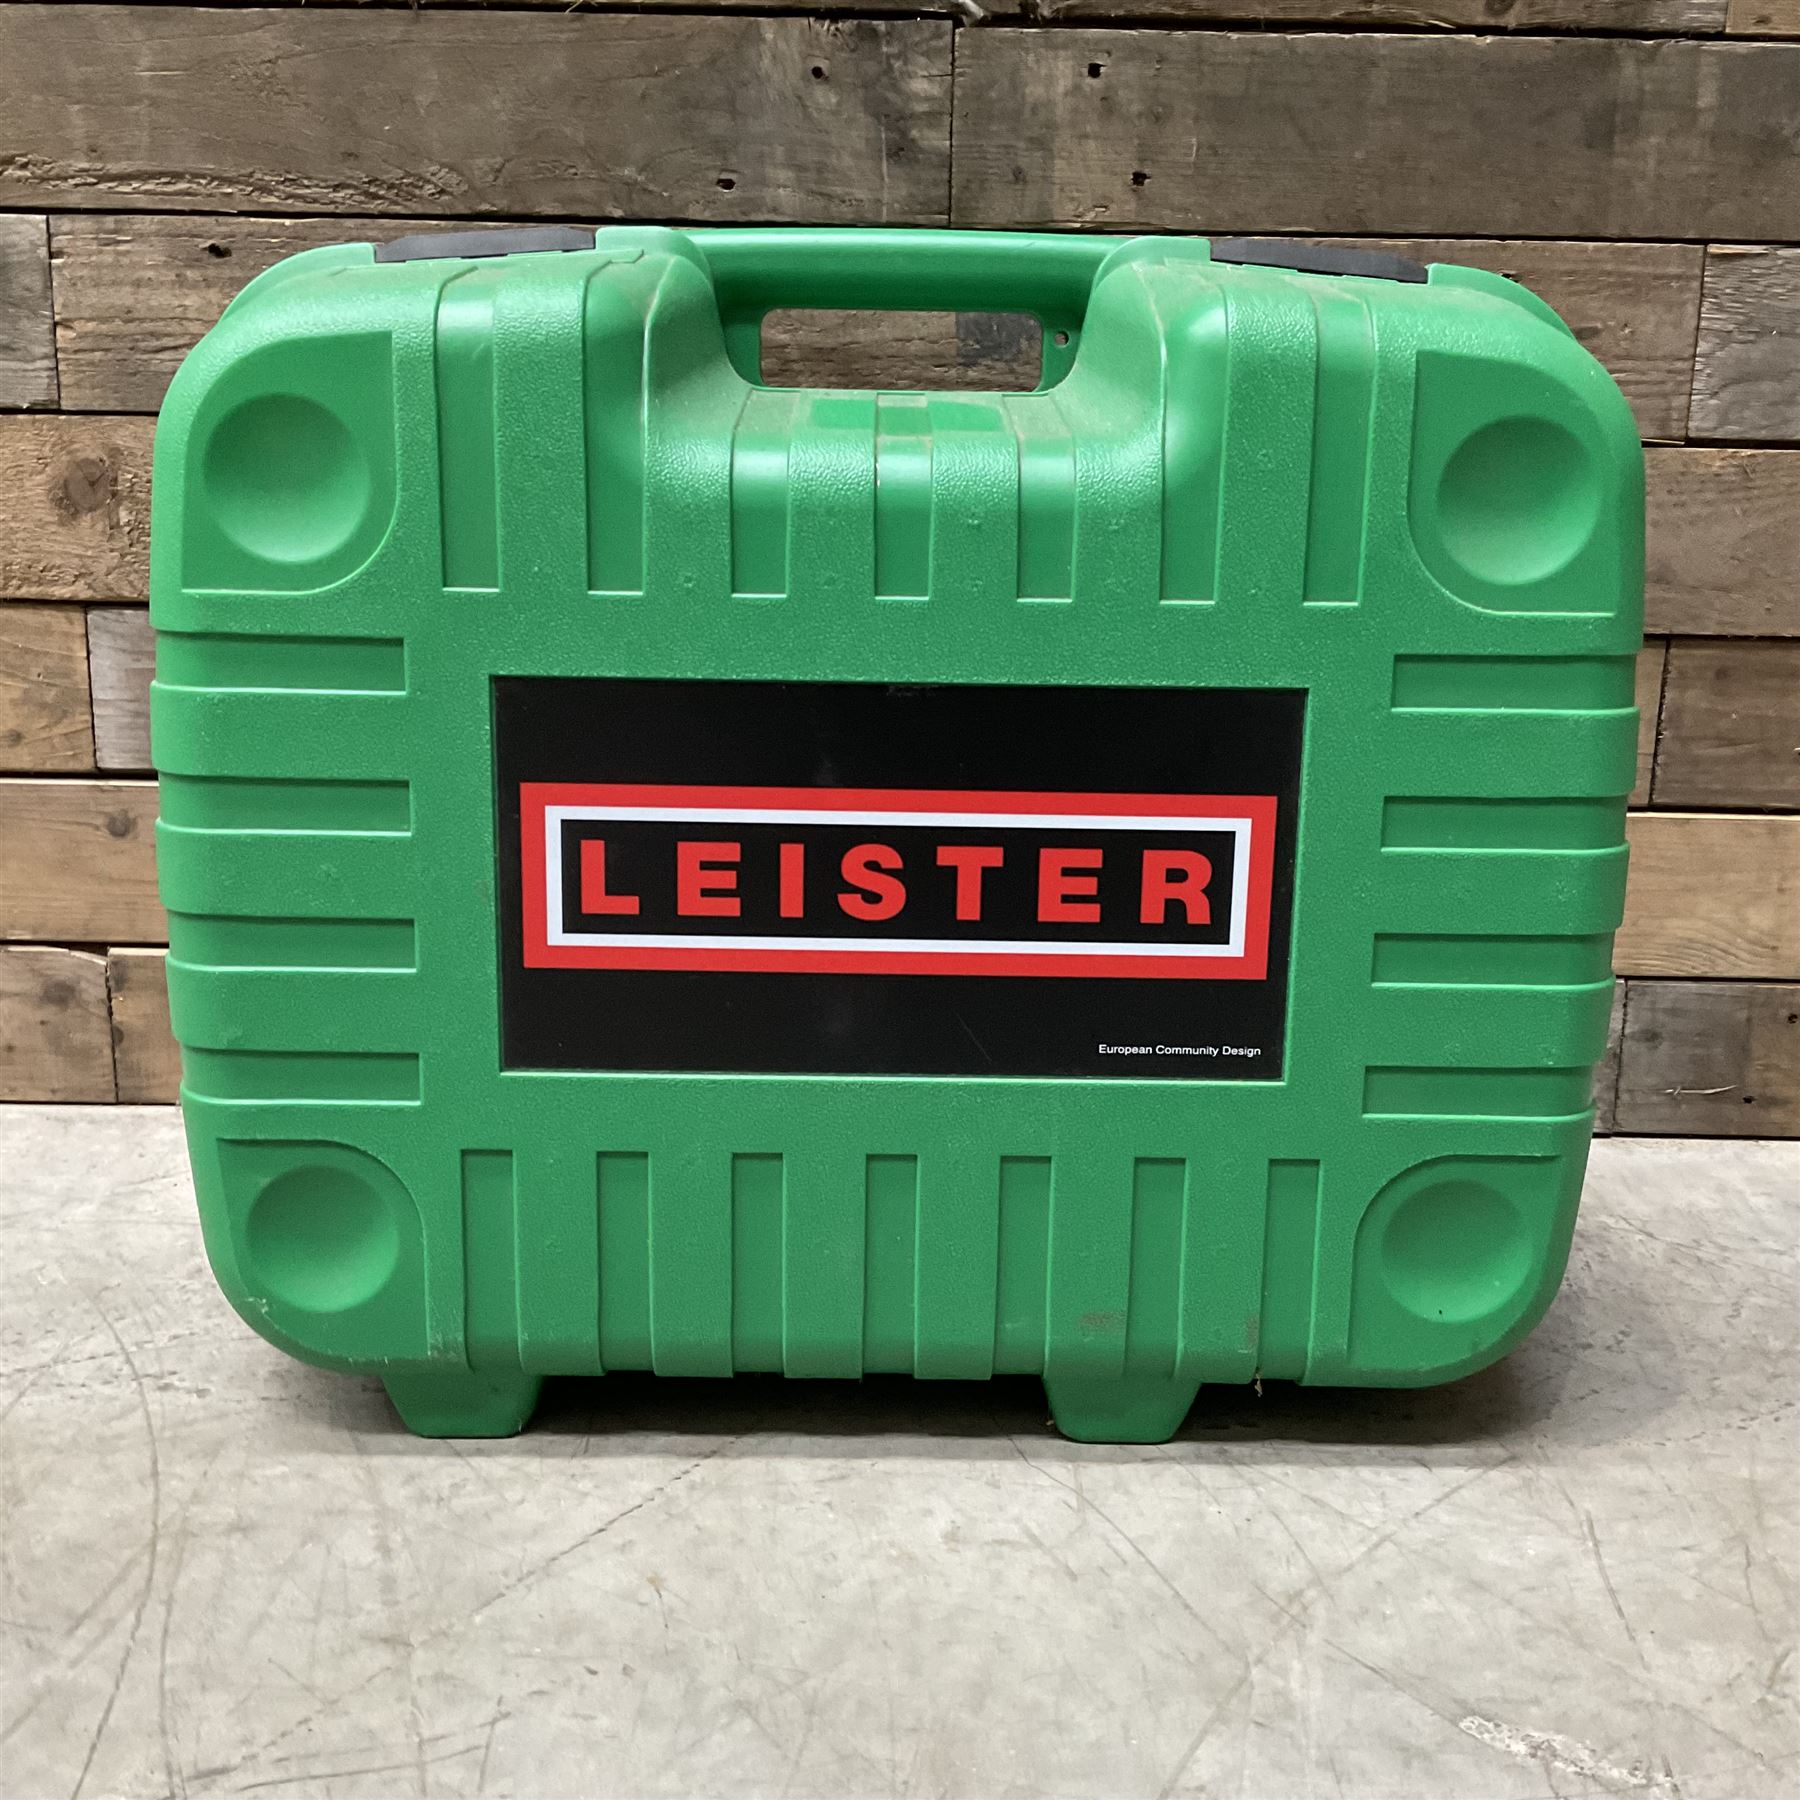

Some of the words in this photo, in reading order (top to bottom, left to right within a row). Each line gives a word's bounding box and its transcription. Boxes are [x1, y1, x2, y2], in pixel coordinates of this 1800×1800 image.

[580, 839, 1212, 925] LEISTER
[1098, 1044, 1153, 1056] European
[1155, 1045, 1220, 1058] Community
[1222, 1045, 1262, 1058] Design
